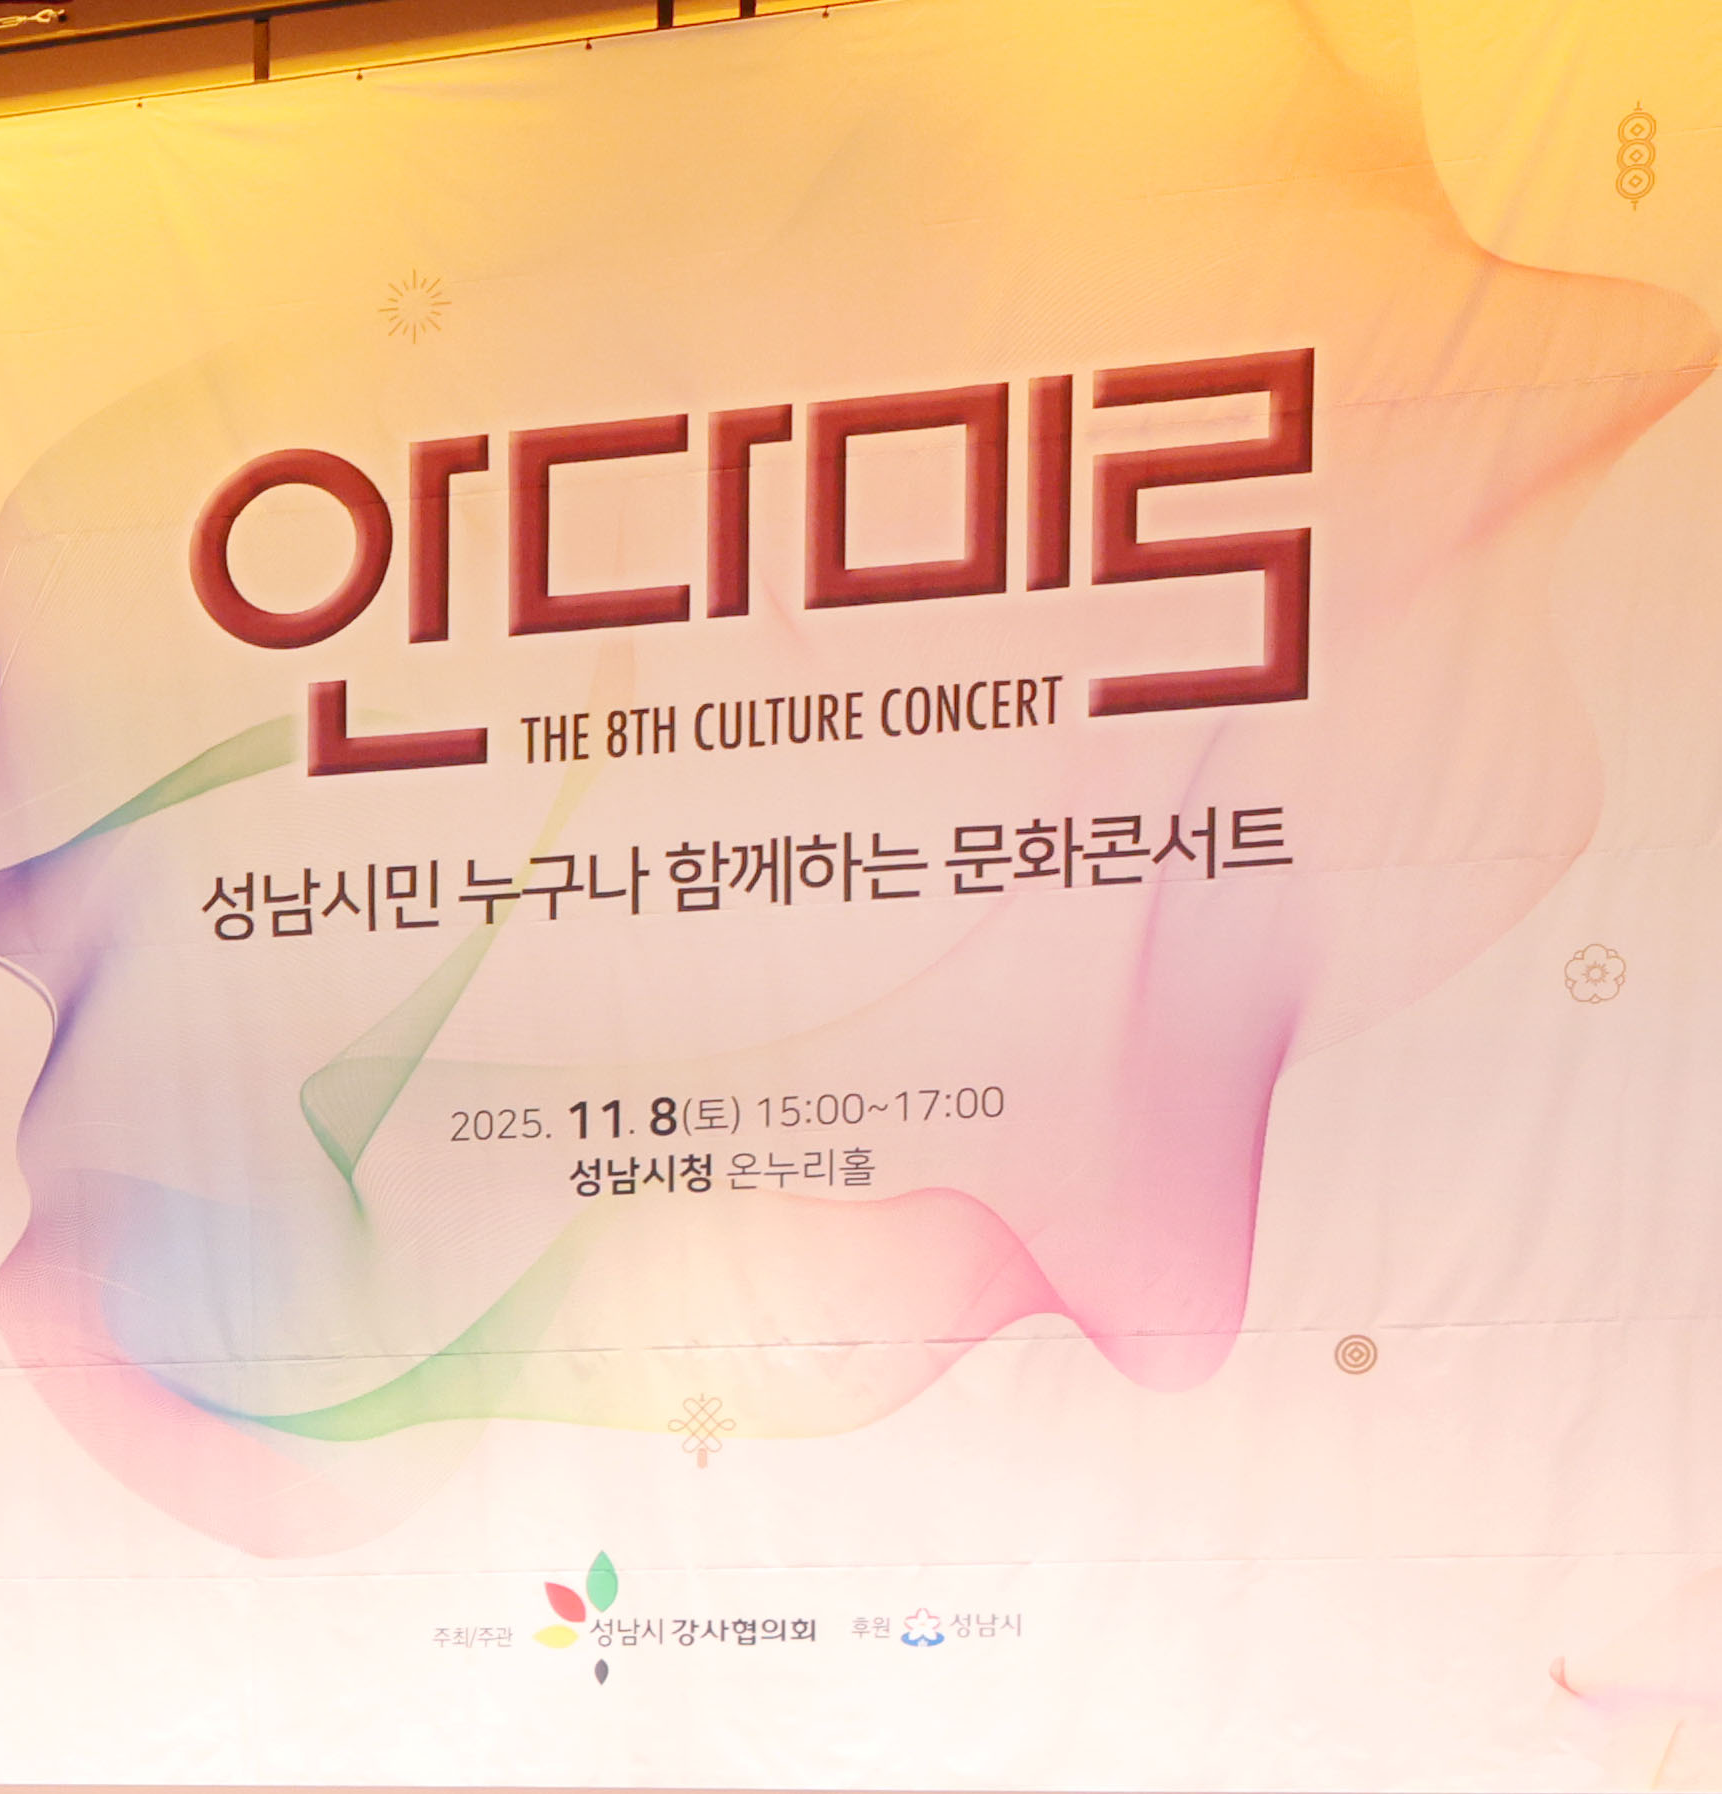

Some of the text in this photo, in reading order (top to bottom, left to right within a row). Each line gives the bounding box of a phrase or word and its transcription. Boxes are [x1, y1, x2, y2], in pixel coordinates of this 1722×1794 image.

[521, 675, 1064, 765] THE 8TH CULTURE CONCERT
[201, 805, 1295, 941] 성남시민 누구나 함께하는 문화콘서트
[450, 1106, 553, 1143] 2025.
[755, 1085, 1006, 1129] 15:00~17:00
[567, 1145, 877, 1198] 성남시청 온누리홀
[431, 1616, 817, 1649] 주최/주관 성남시 강사협의회
[851, 1612, 1023, 1639] 후원 성남시
